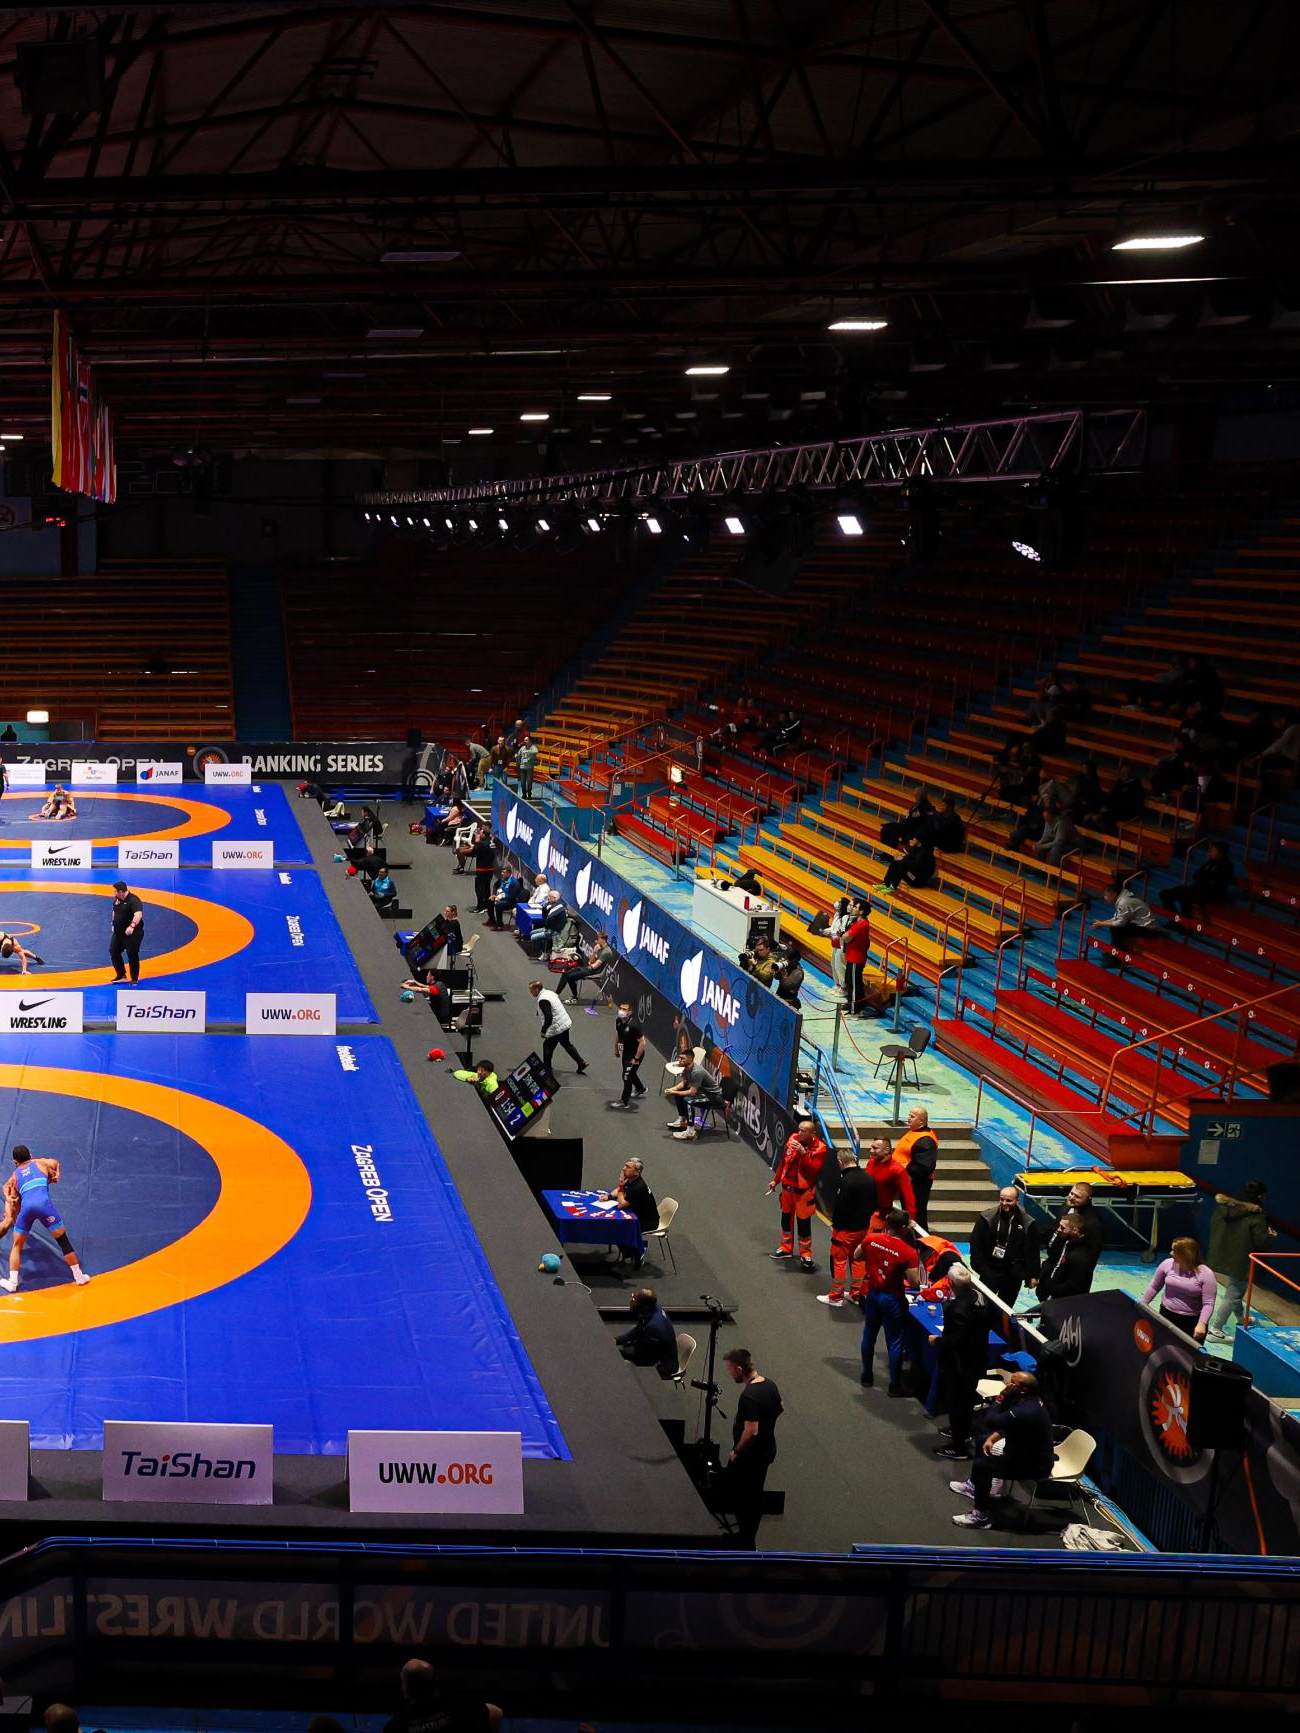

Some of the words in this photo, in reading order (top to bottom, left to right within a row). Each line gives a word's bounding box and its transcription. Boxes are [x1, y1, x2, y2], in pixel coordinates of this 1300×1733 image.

[242, 755, 321, 772] RANKING
[327, 755, 384, 772] SERIES
[42, 858, 81, 866] WRESTLING
[125, 850, 173, 860] TaiShan
[222, 851, 263, 859] UWW.ORG
[548, 846, 569, 878] JANAF
[589, 881, 614, 916] JANAF
[639, 923, 670, 965] JANAF
[701, 976, 741, 1026] JANAF
[126, 1005, 196, 1019] TaiShan
[261, 1009, 321, 1021] UWW.ORG
[10, 1017, 67, 1029] WRESTLING
[351, 1145, 381, 1186] ZAGREB
[366, 1188, 394, 1222] OPEN
[870, 1241, 899, 1257] CROATIA
[121, 1451, 256, 1479] TaiShan
[379, 1462, 493, 1485] UWW.ORG
